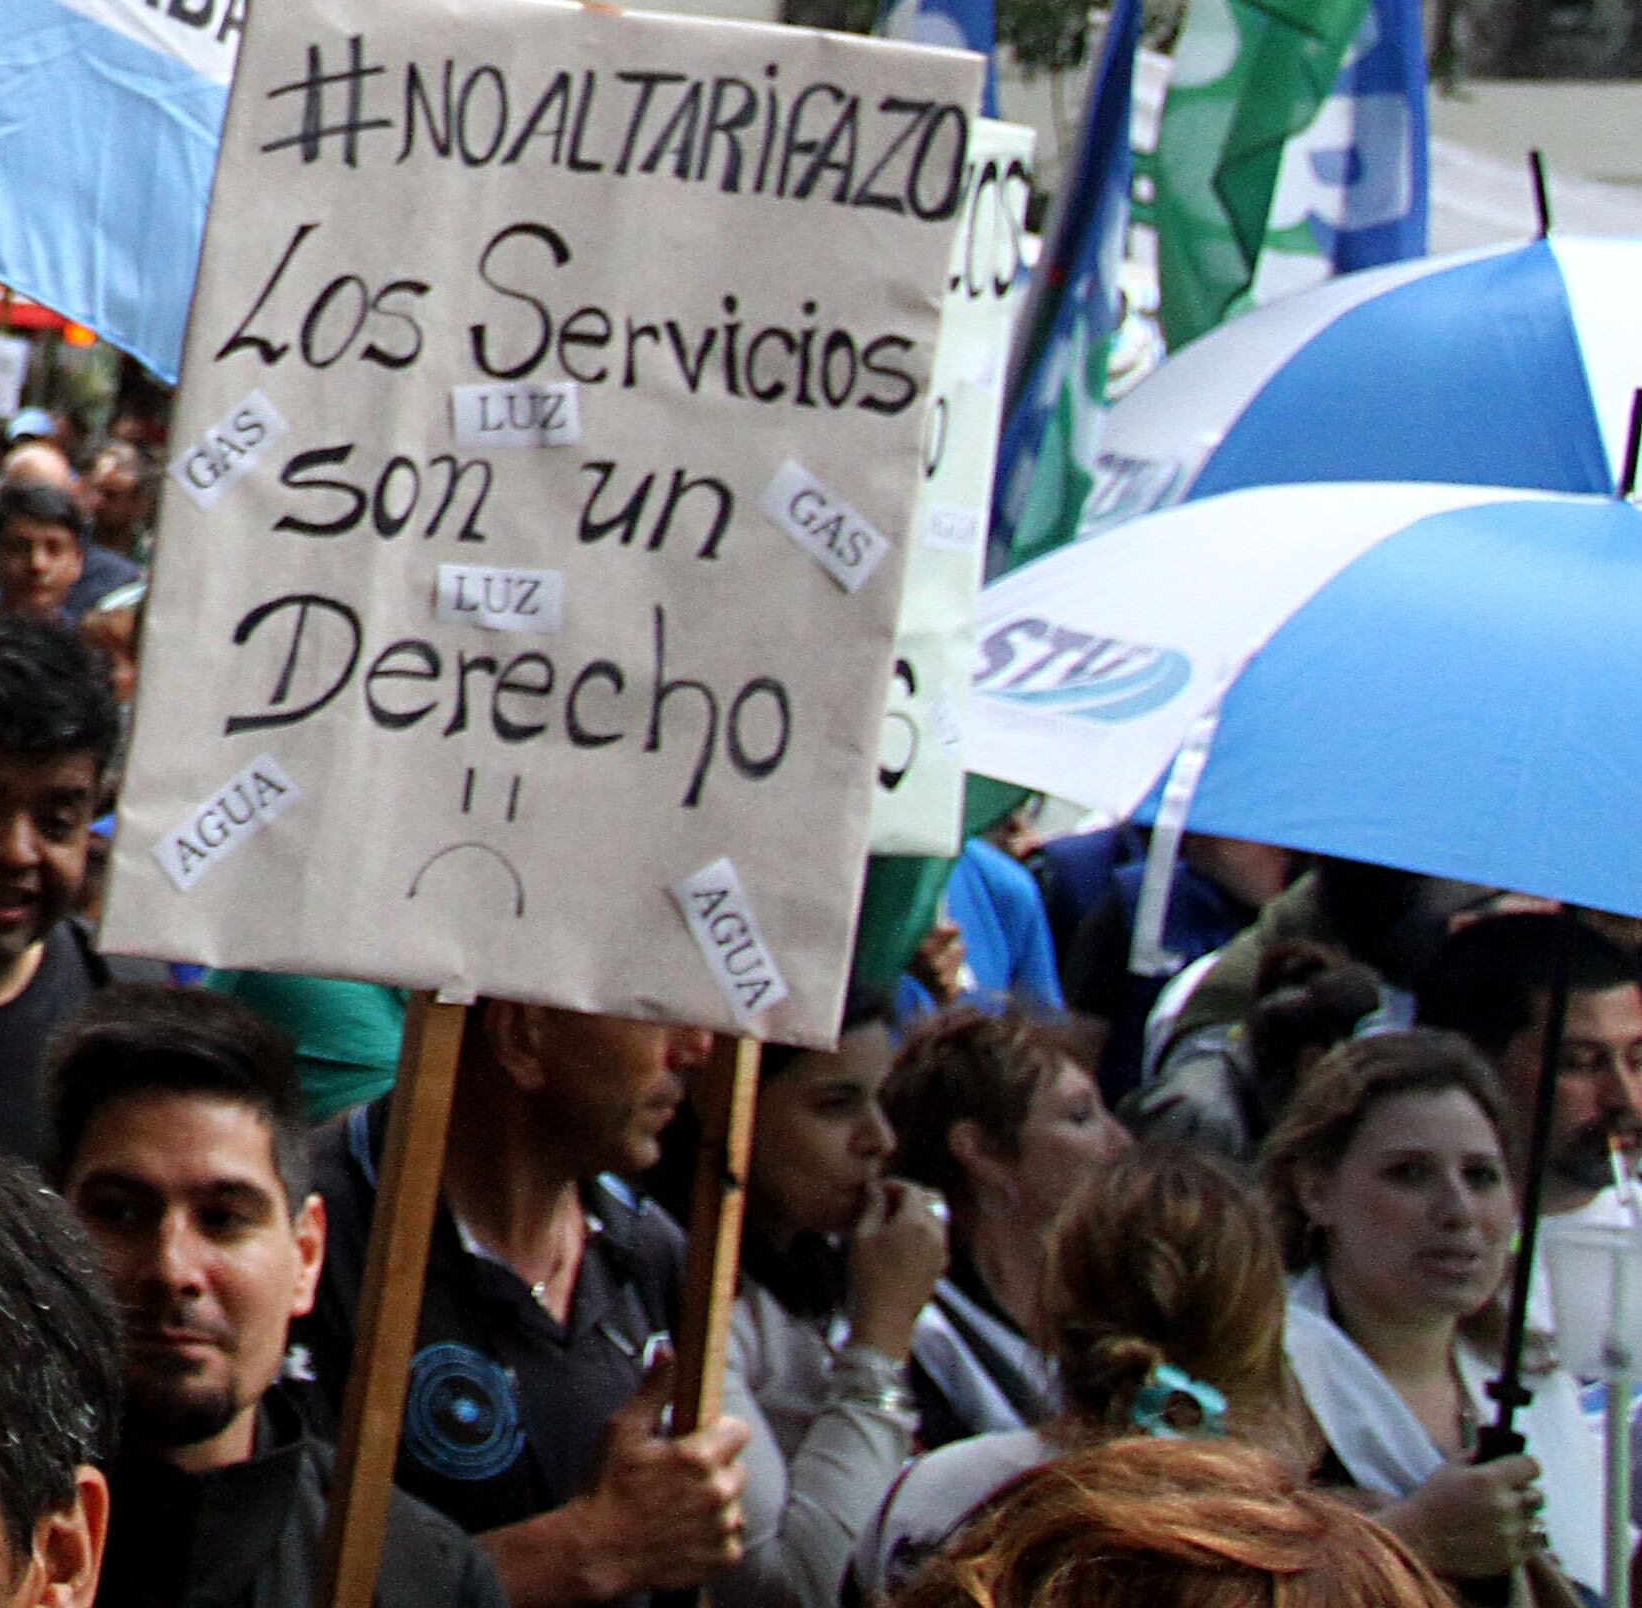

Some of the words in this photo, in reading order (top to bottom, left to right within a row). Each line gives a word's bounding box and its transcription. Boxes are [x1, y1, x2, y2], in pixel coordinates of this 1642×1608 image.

[468, 221, 918, 417] Servicios
[184, 407, 268, 496] GAS
[477, 392, 567, 433] LUZ
[273, 442, 498, 544] son
[576, 457, 736, 560] un
[787, 487, 875, 570] GAS
[451, 577, 542, 618] LUZ
[223, 593, 792, 808] Derecho
[167, 766, 291, 876] AGUA
[689, 882, 773, 1014] AGUA
